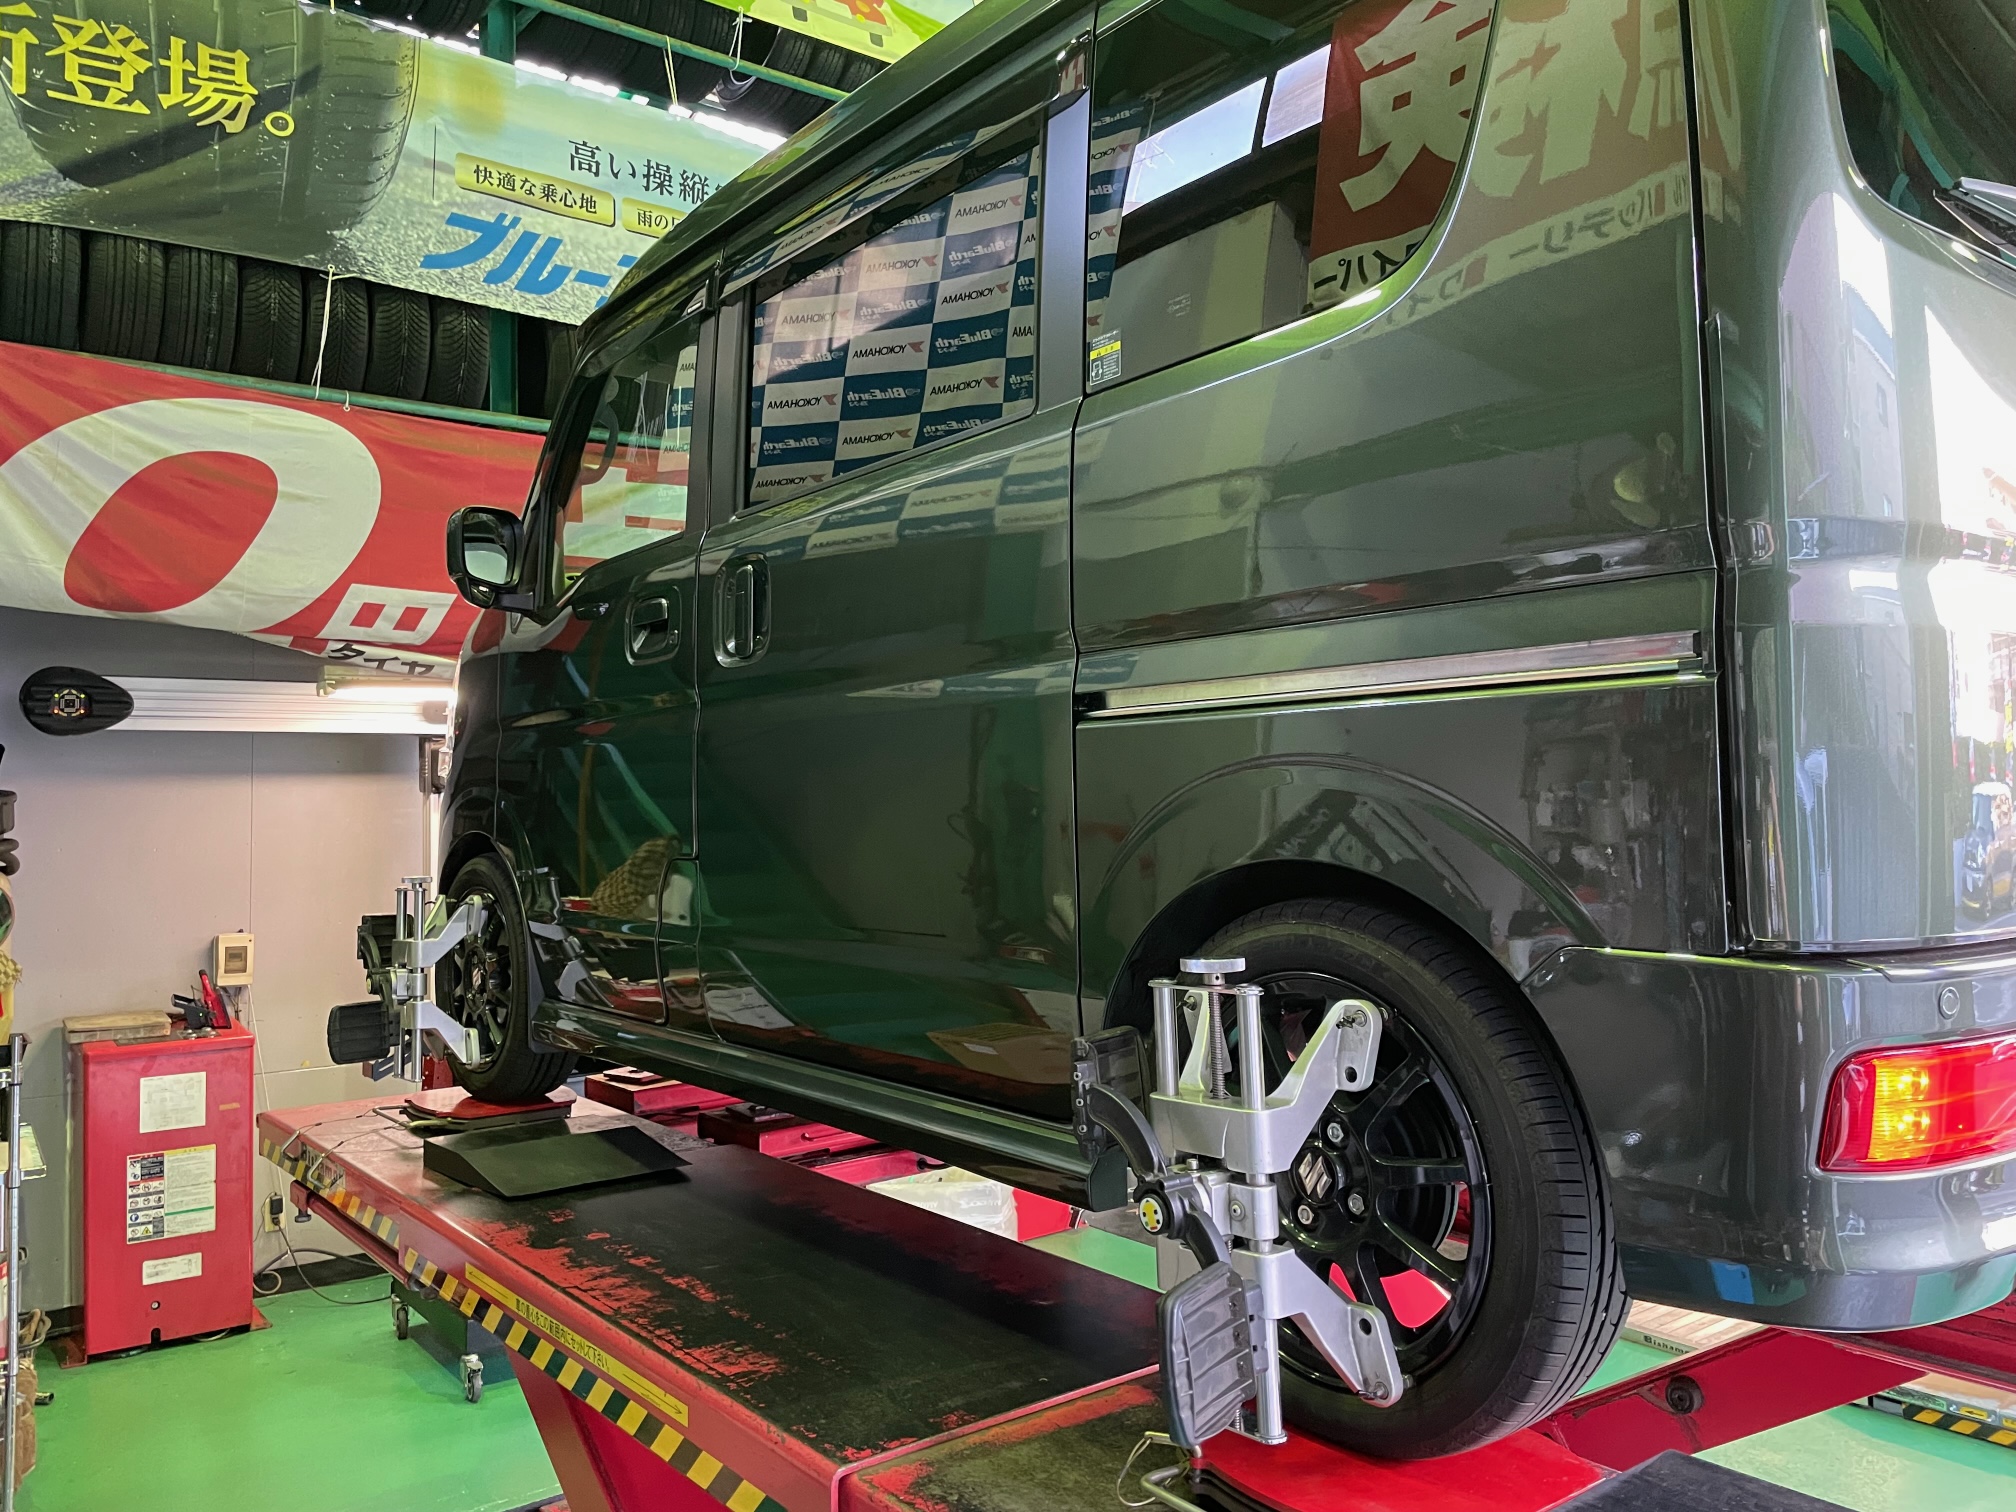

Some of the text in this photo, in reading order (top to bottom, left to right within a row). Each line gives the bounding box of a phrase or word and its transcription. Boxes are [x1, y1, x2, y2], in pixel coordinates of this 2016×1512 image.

[473, 164, 598, 215] 快適な乗心地
[568, 139, 722, 205] 高い操縦
[327, 643, 436, 676] タイヤ
